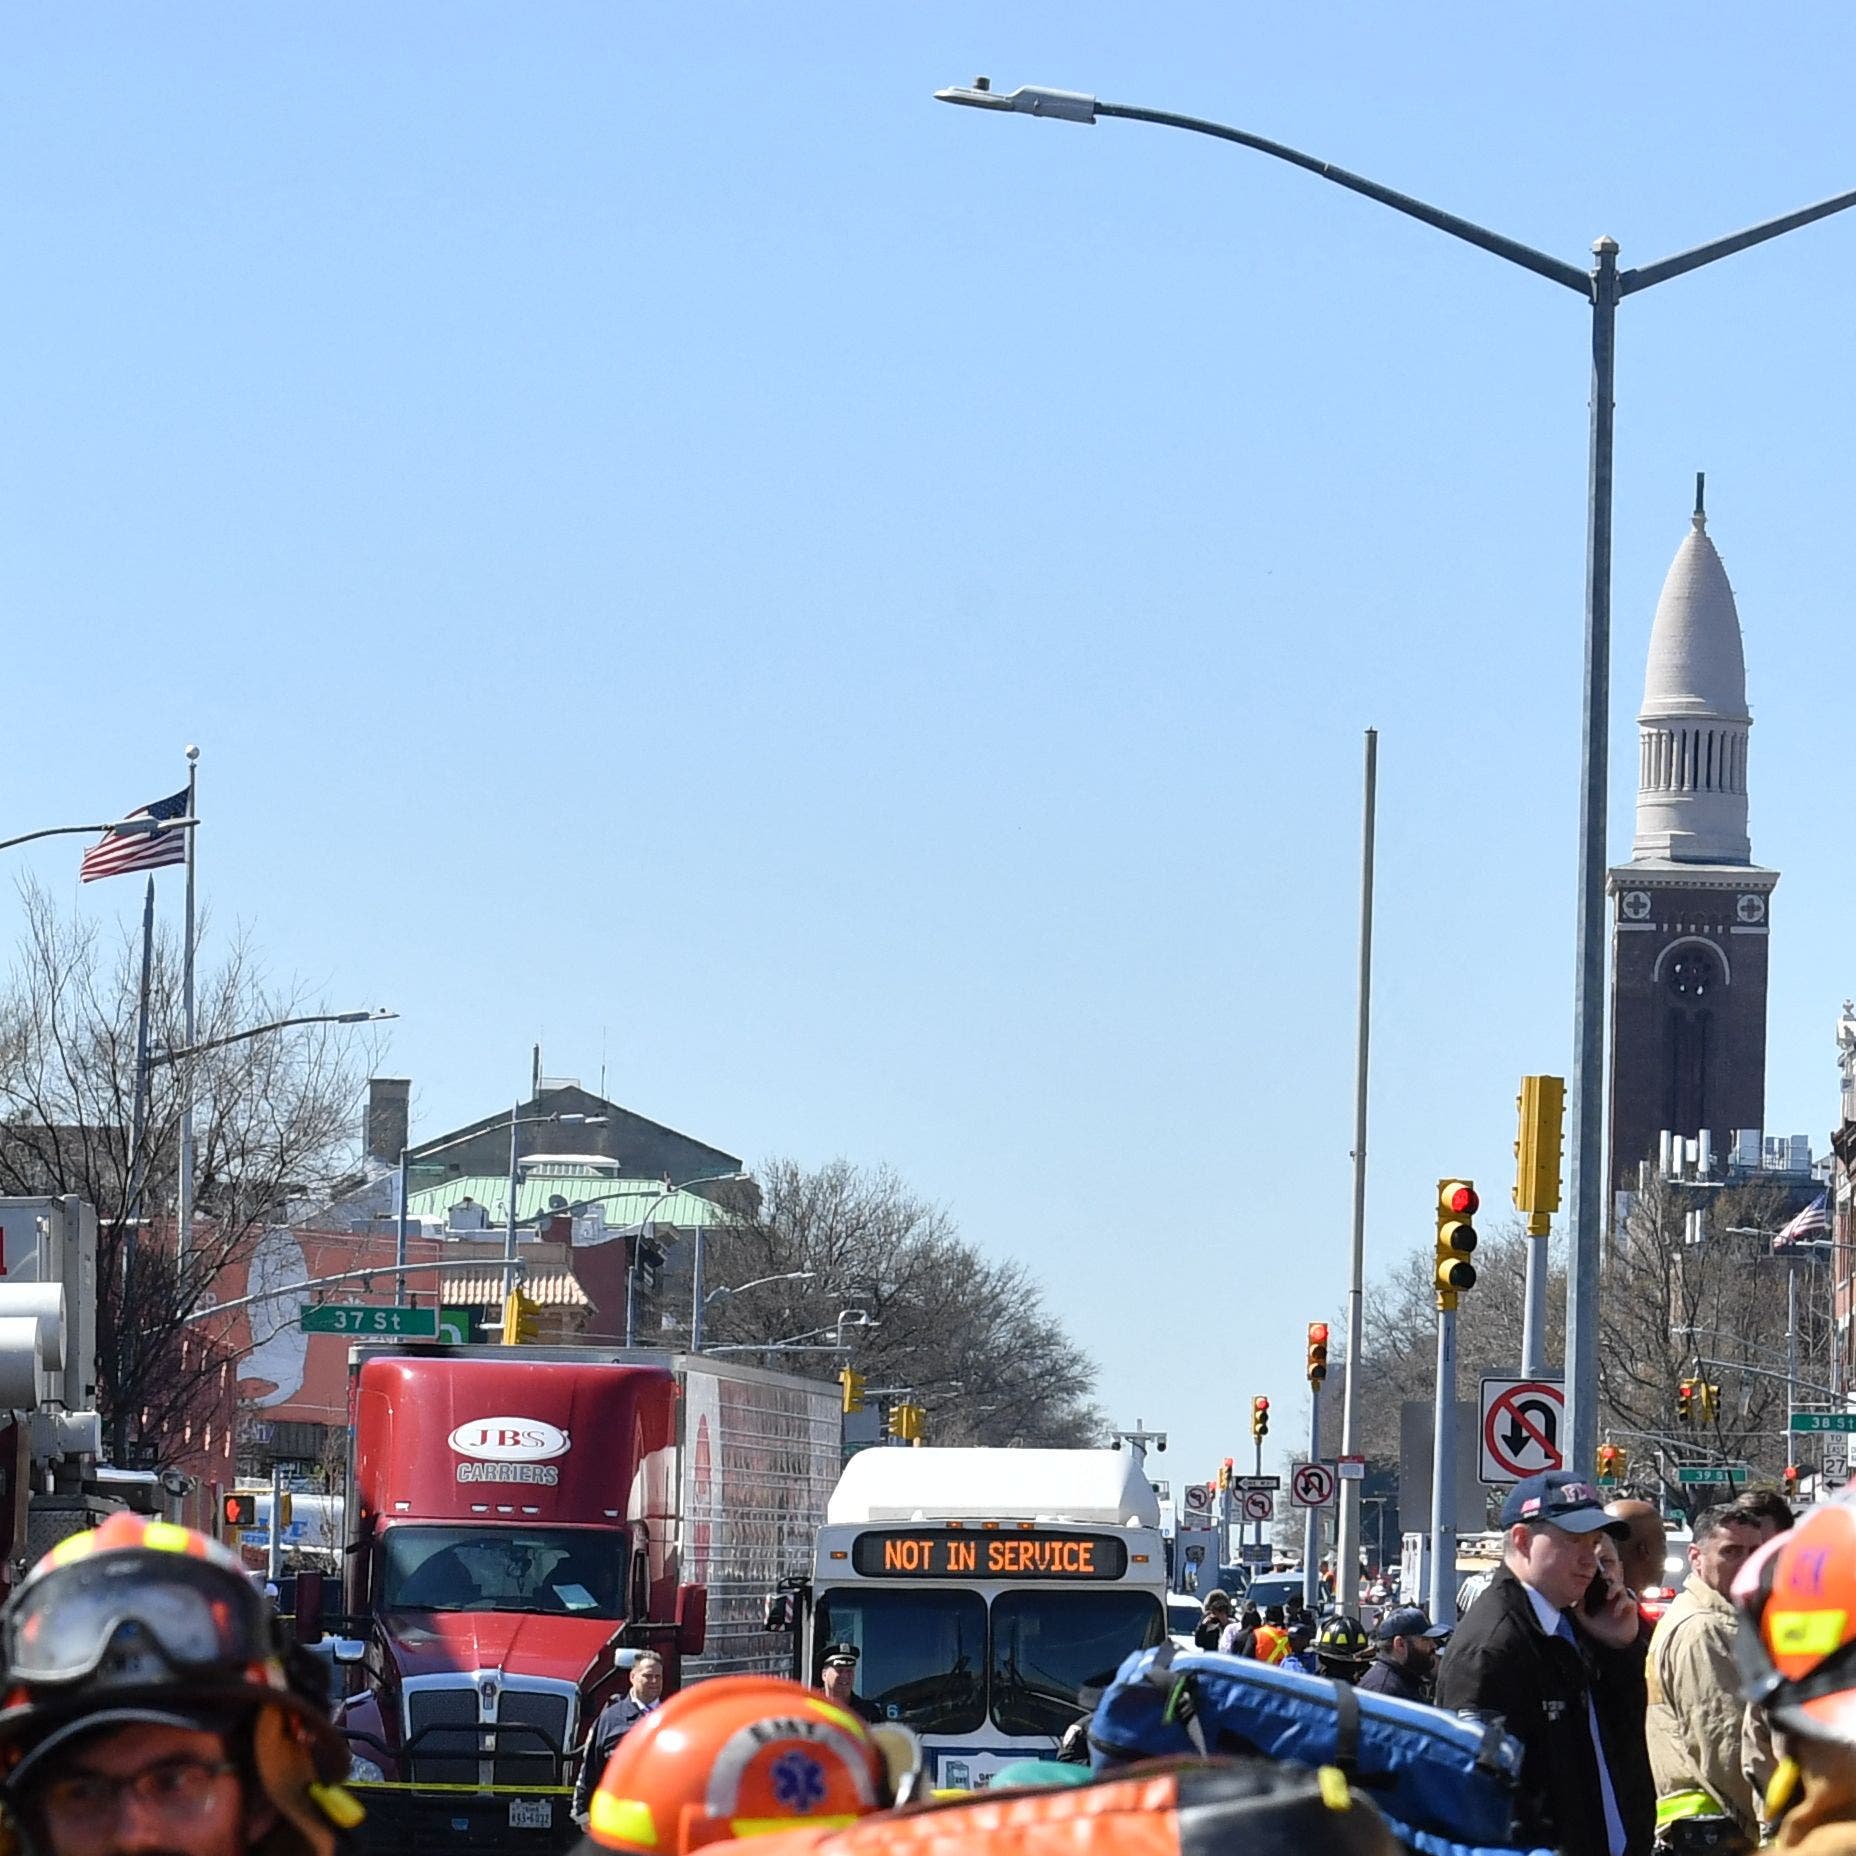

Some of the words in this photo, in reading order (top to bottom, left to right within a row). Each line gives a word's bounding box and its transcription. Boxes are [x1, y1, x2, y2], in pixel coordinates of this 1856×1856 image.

[334, 1310, 364, 1330] 37
[374, 1311, 401, 1331] St
[1811, 1416, 1831, 1429] 38
[1837, 1416, 1855, 1430] St
[469, 1429, 545, 1448] JBS
[1831, 1434, 1843, 1442] TO
[457, 1463, 559, 1486] CARRIERS
[1825, 1459, 1845, 1474] 27
[1695, 1470, 1714, 1481] 39
[885, 1540, 934, 1571] NOT
[946, 1541, 975, 1571] IN
[988, 1541, 1094, 1573] SERVICE
